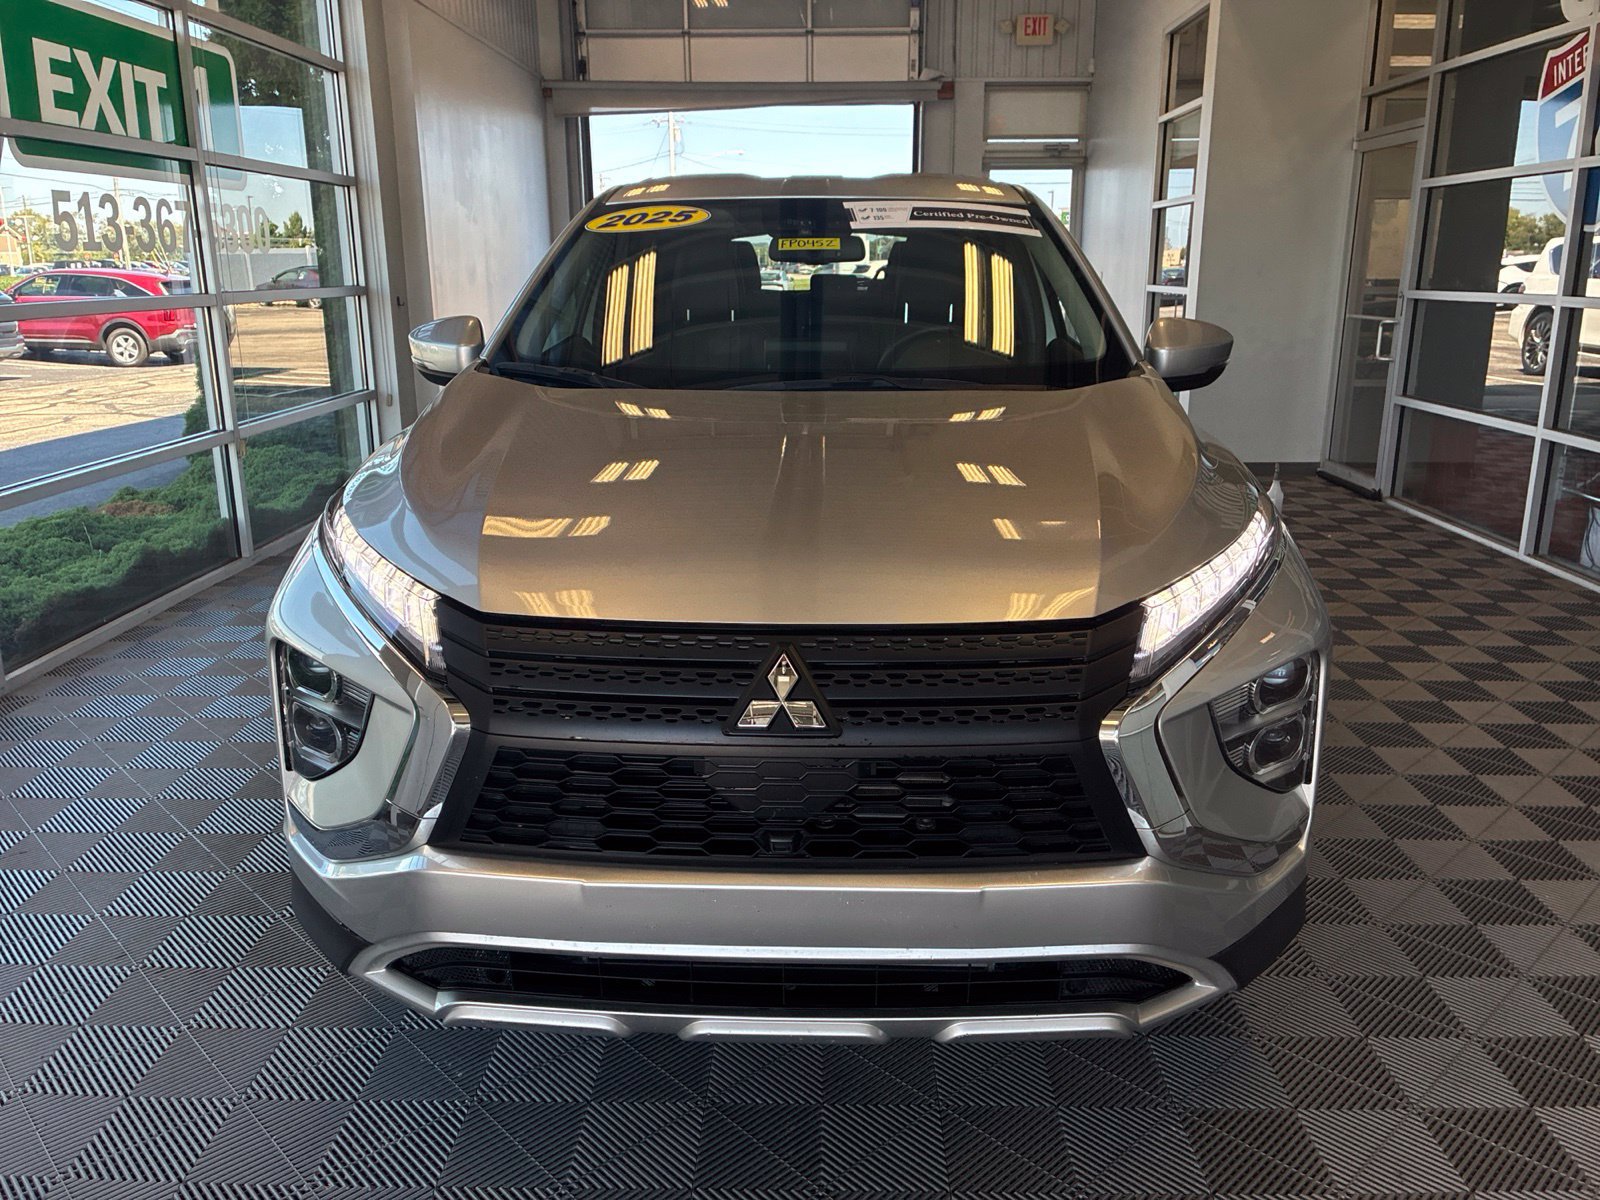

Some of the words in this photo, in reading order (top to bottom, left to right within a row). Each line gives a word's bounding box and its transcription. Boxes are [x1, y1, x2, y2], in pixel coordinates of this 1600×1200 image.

[1024, 16, 1048, 36] EXIT
[1553, 45, 1588, 87] INTER
[31, 37, 168, 144] EXIT
[596, 210, 698, 230] 2025
[913, 210, 964, 219] Certified
[966, 212, 1029, 225] Pre-Owned
